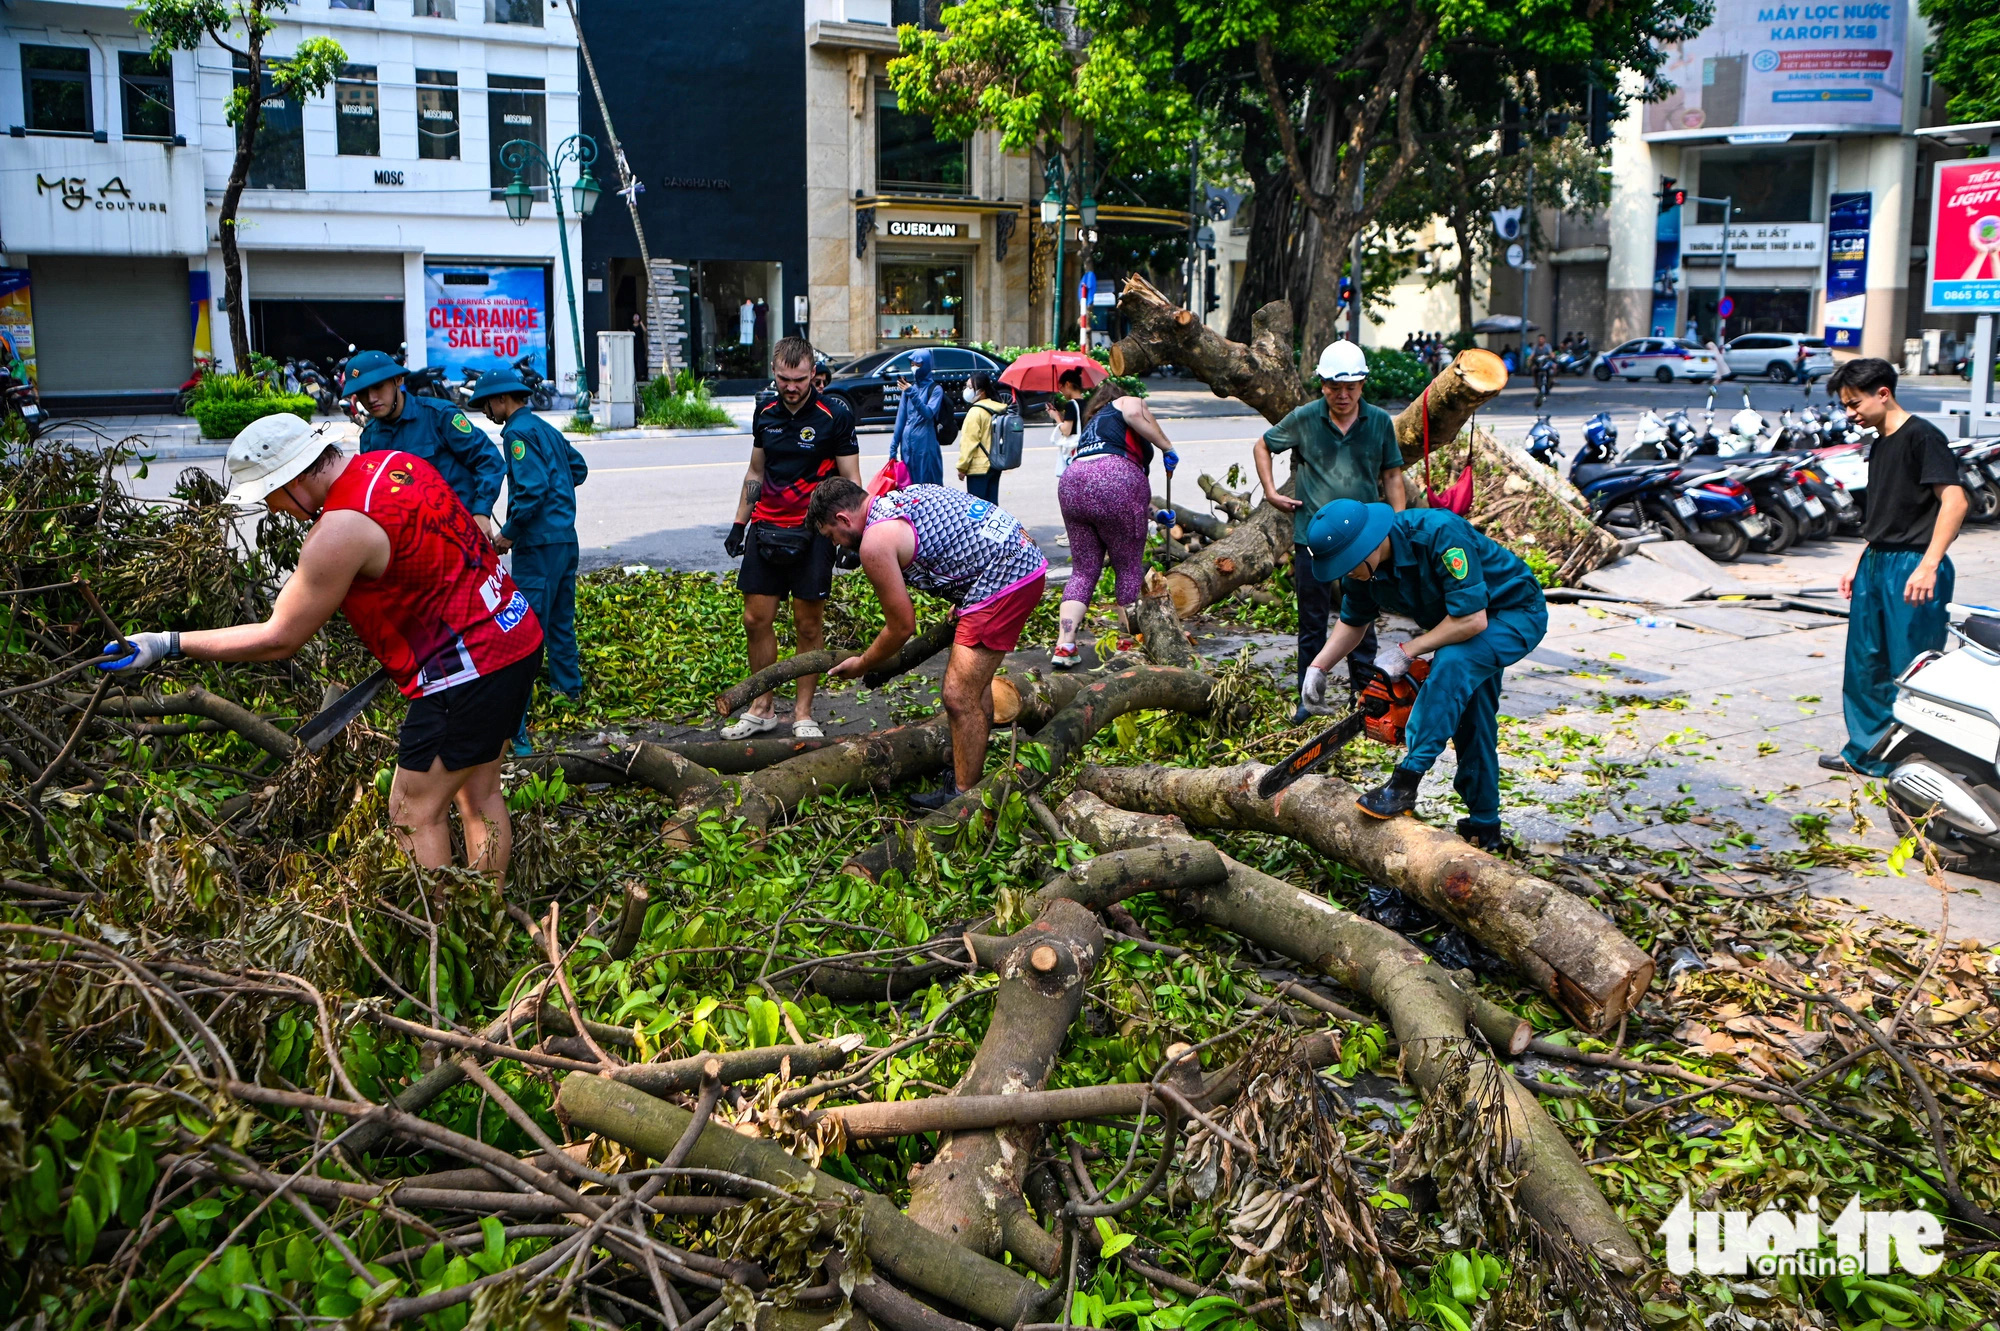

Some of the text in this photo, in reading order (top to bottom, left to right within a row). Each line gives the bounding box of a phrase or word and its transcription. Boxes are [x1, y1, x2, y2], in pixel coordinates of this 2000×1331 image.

[1758, 3, 1891, 22] MÁY LỌC NƯỚC
[1771, 26, 1839, 40] KAROFI
[342, 104, 373, 115] MOSCHINO
[424, 109, 453, 119] MOSCHINO
[504, 114, 532, 125] MOSCHINO
[374, 169, 404, 185] MOSC
[98, 176, 131, 198] A
[1947, 189, 1998, 208] LIGHT
[95, 201, 166, 213] COUTURE
[890, 221, 956, 237] GUERLAIN
[437, 298, 454, 306] NEW
[457, 298, 492, 306] ARRIVALS
[1943, 290, 1972, 300] 0865
[1975, 290, 1990, 300] 86
[429, 307, 538, 328] CLEARANCE
[448, 328, 491, 348] SALE
[1297, 743, 1322, 770] ECHO
